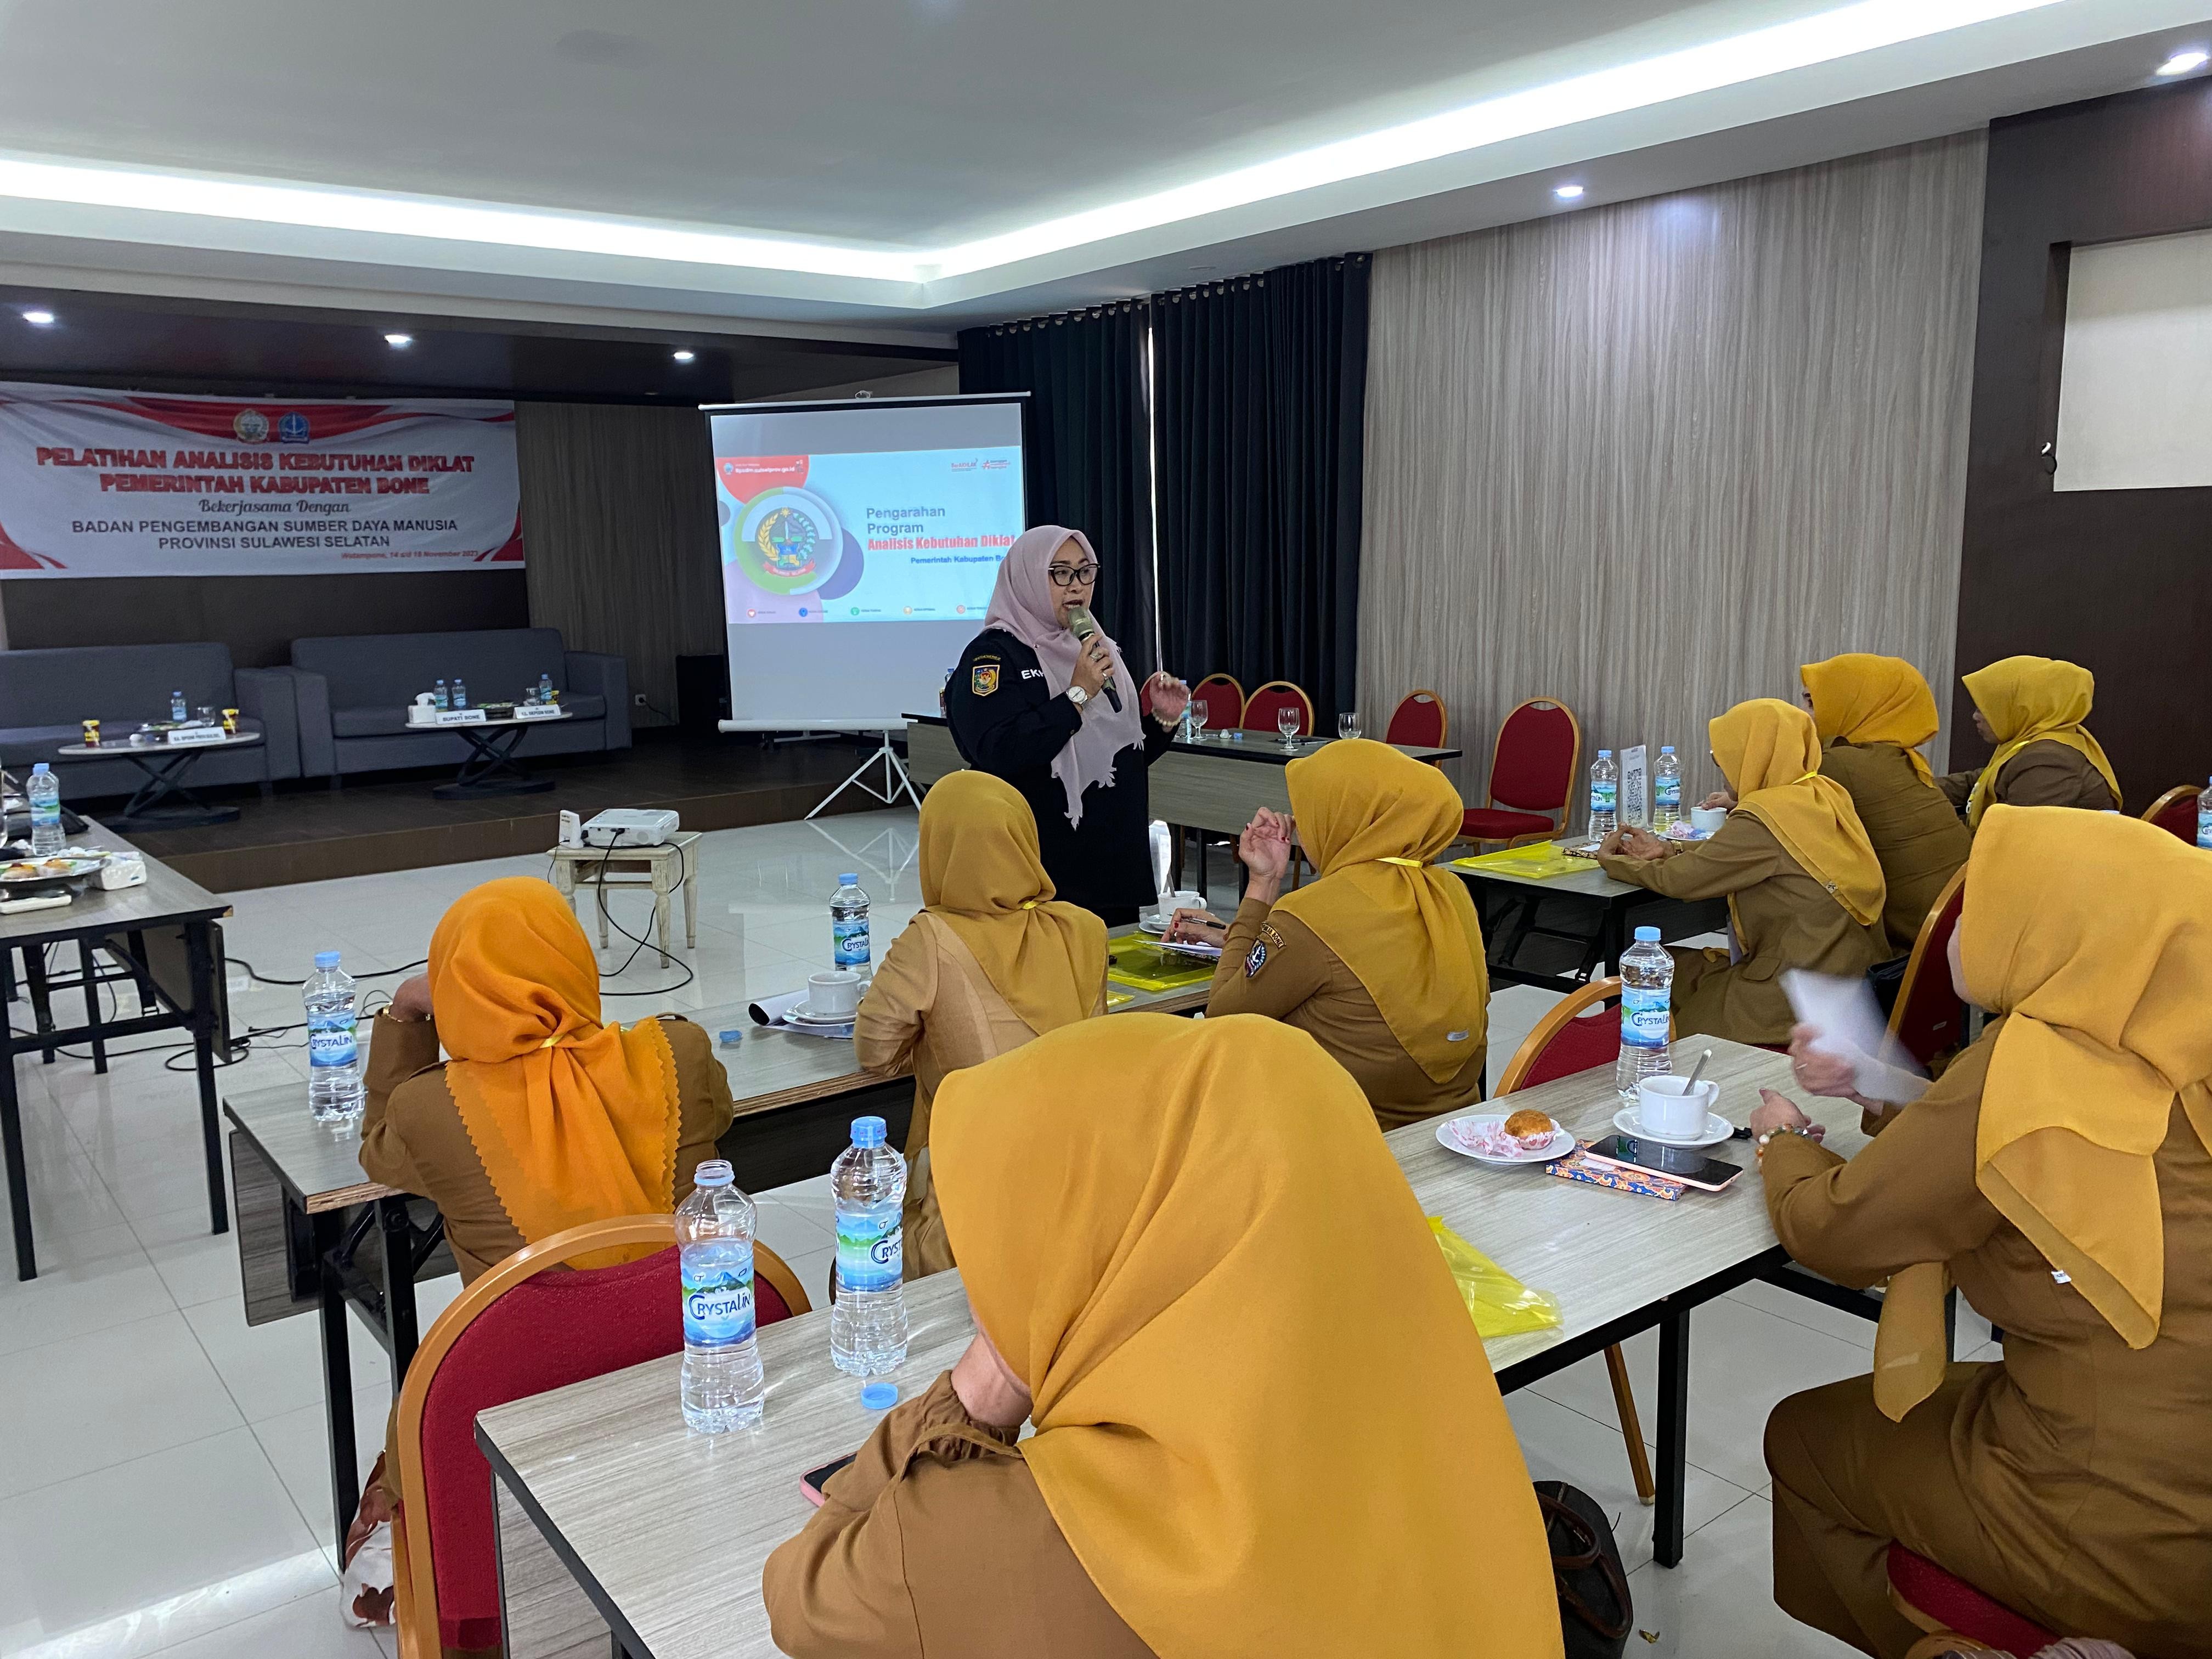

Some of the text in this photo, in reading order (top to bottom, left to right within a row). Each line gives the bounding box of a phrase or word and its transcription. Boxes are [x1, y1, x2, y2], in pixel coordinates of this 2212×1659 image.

[36, 447, 474, 472] PELATIHAN ANALISIS KEBUTUHAN DIKLAT
[100, 473, 430, 494] PEMERINTAH KABUPATEN BONE
[199, 499, 351, 516] Bekerjasama Dengan
[866, 506, 945, 520] Pengarahan
[72, 520, 458, 533] BADAN PENGEMBANGAN SUMBER DAYA MANUSIA
[868, 523, 924, 535] Program
[159, 535, 390, 549] PROVINSI SULAWESI SELATAN
[868, 537, 913, 550] Analisis
[916, 537, 978, 549] Kebutuhan
[911, 556, 952, 564] Pemerintah
[954, 555, 994, 564] Kabupaten
